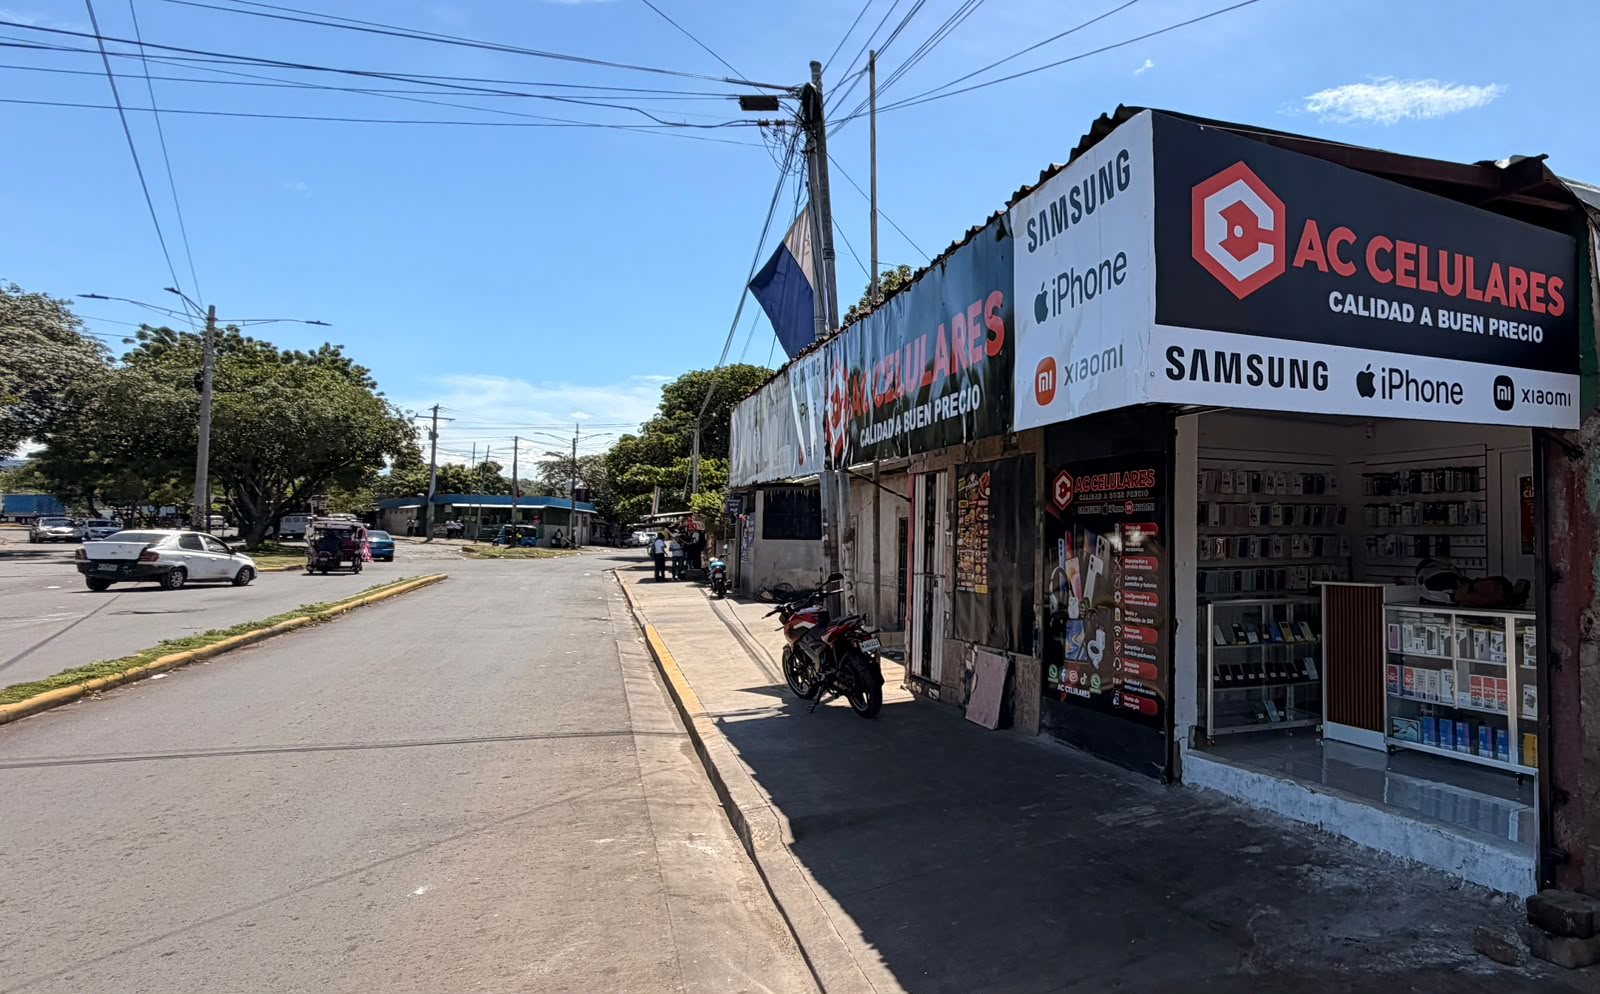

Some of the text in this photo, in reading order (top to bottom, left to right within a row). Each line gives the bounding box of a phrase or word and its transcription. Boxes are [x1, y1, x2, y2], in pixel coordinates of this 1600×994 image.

[1026, 148, 1131, 254] SAMSUNG
[1051, 250, 1128, 321] iPhone
[1293, 219, 1566, 317] AC CELULARES
[1328, 290, 1544, 344] CALIDAD A BUEN PRECIO
[871, 290, 1006, 408] CELULARES
[1063, 342, 1124, 388] xiaomi
[1166, 346, 1329, 392] SAMSUNG
[1380, 366, 1464, 406] iPhone
[1521, 387, 1572, 407] xiaomi
[860, 384, 980, 448] CALIDAD A BUEN PRECIO
[1074, 469, 1155, 493] AC CELULARES
